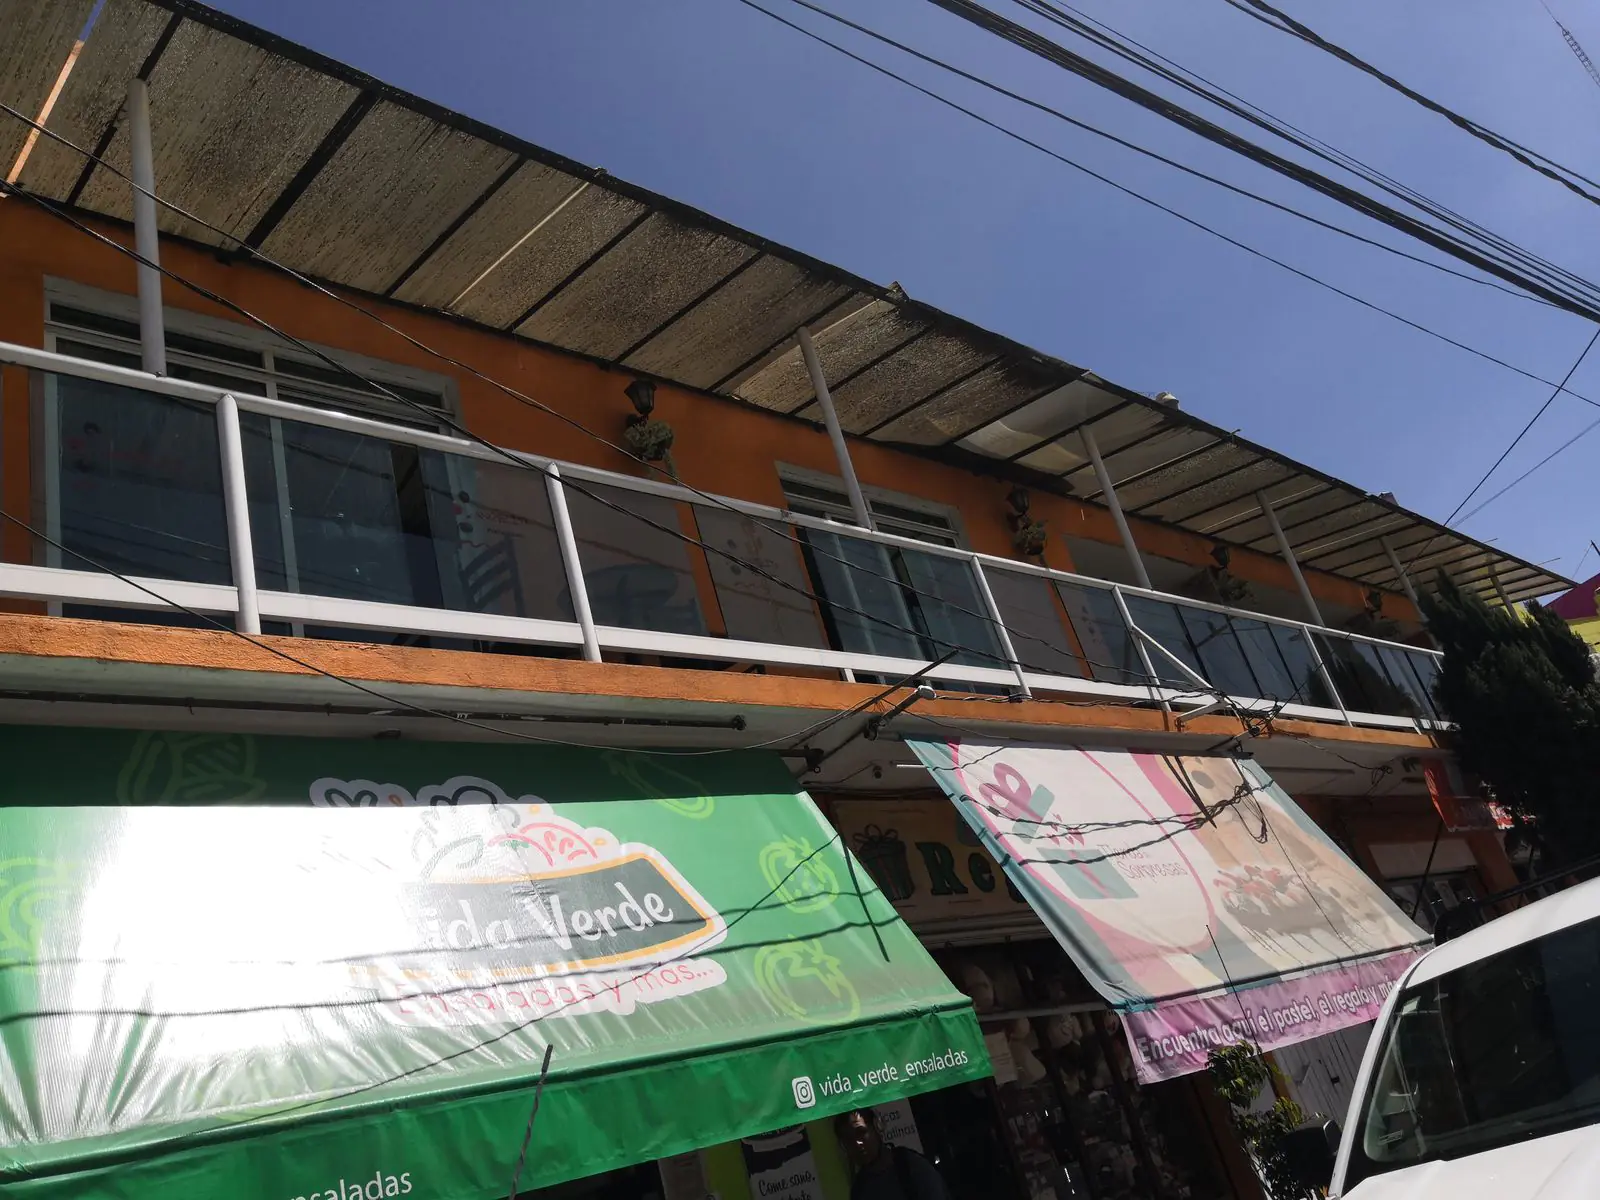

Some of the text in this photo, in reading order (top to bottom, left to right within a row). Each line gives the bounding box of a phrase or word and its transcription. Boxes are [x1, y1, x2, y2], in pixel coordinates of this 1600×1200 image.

[418, 881, 673, 951] ida Verde
[601, 979, 621, 1004] y
[1137, 1026, 1221, 1062] Encuentra
[1222, 1009, 1257, 1041] aquí
[1258, 1009, 1274, 1032] el
[1273, 997, 1320, 1033] pastel,
[1319, 993, 1334, 1016] el
[1333, 986, 1369, 1013] regalo
[1368, 987, 1379, 1005] y
[819, 1048, 968, 1097] vida_verde_ensaladas
[290, 1170, 413, 1200] aladas
[758, 1179, 788, 1197] Come
